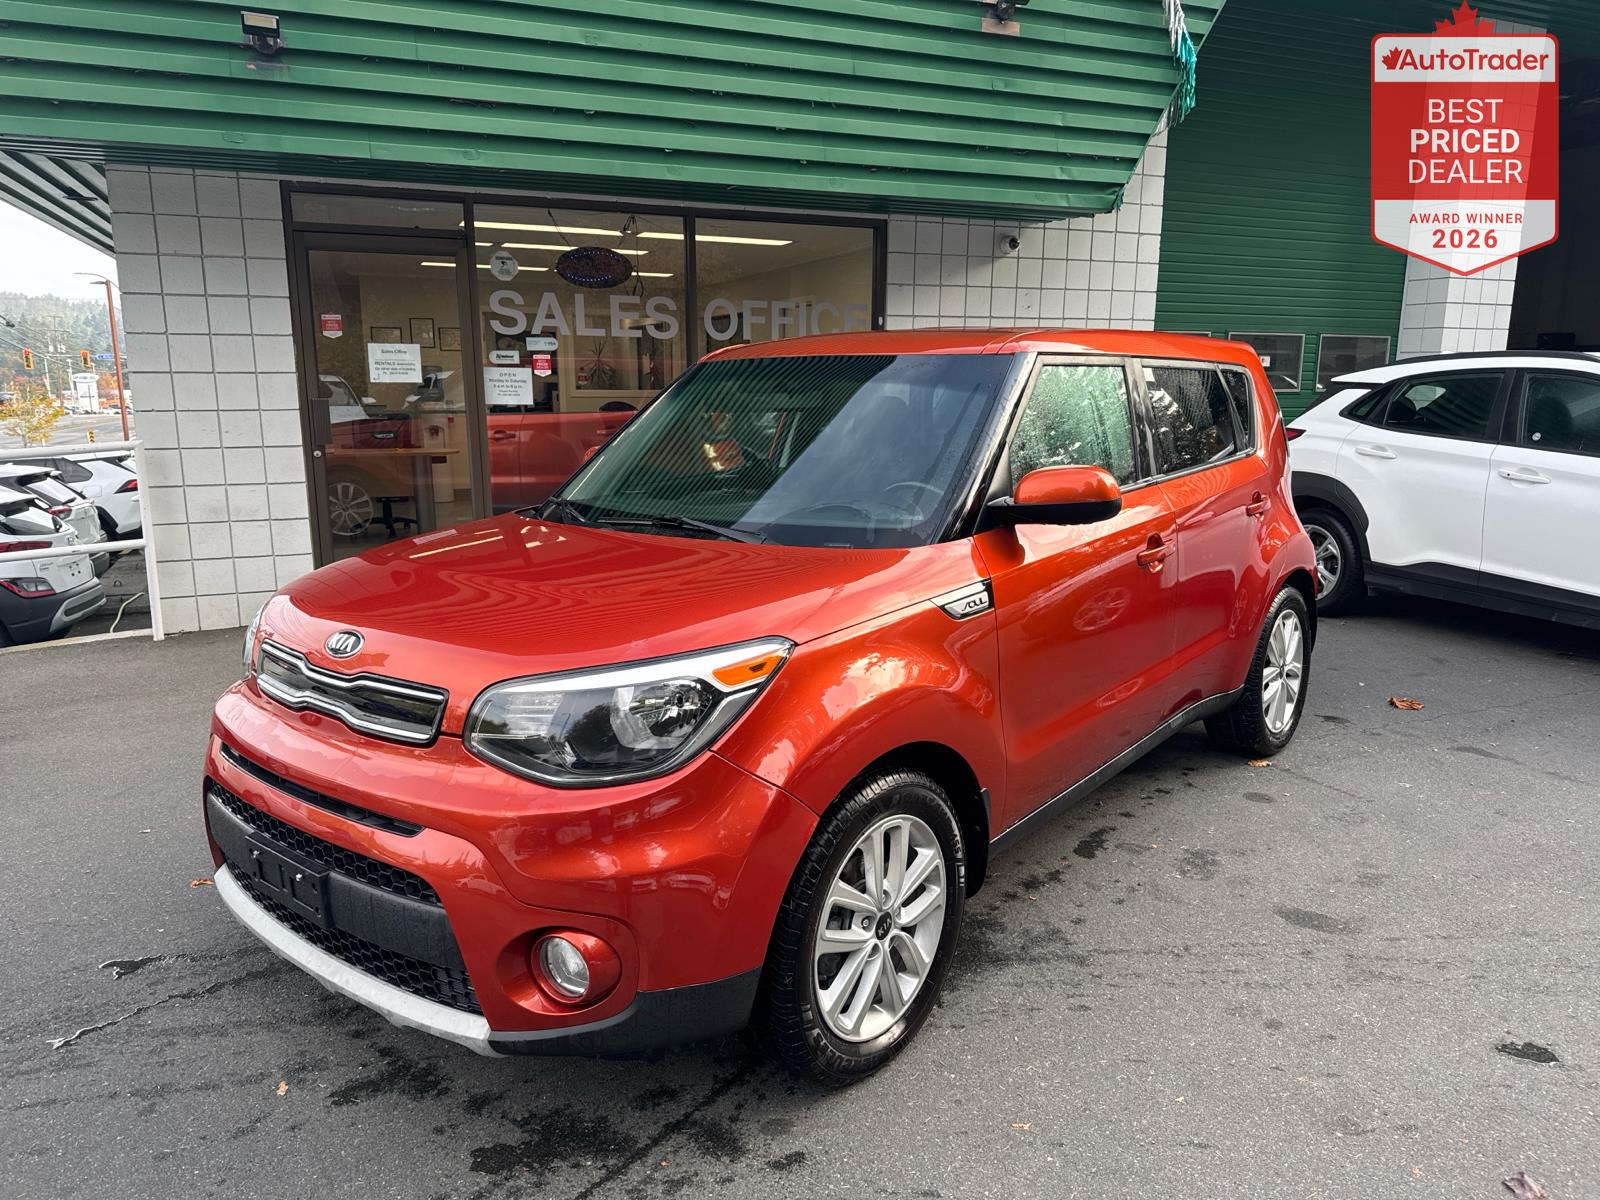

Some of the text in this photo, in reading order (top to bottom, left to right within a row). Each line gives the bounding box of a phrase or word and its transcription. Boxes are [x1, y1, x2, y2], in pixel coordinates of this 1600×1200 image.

[489, 289, 868, 341] SALES OFFICE
[327, 632, 357, 652] KIA
[878, 918, 891, 937] KIA
